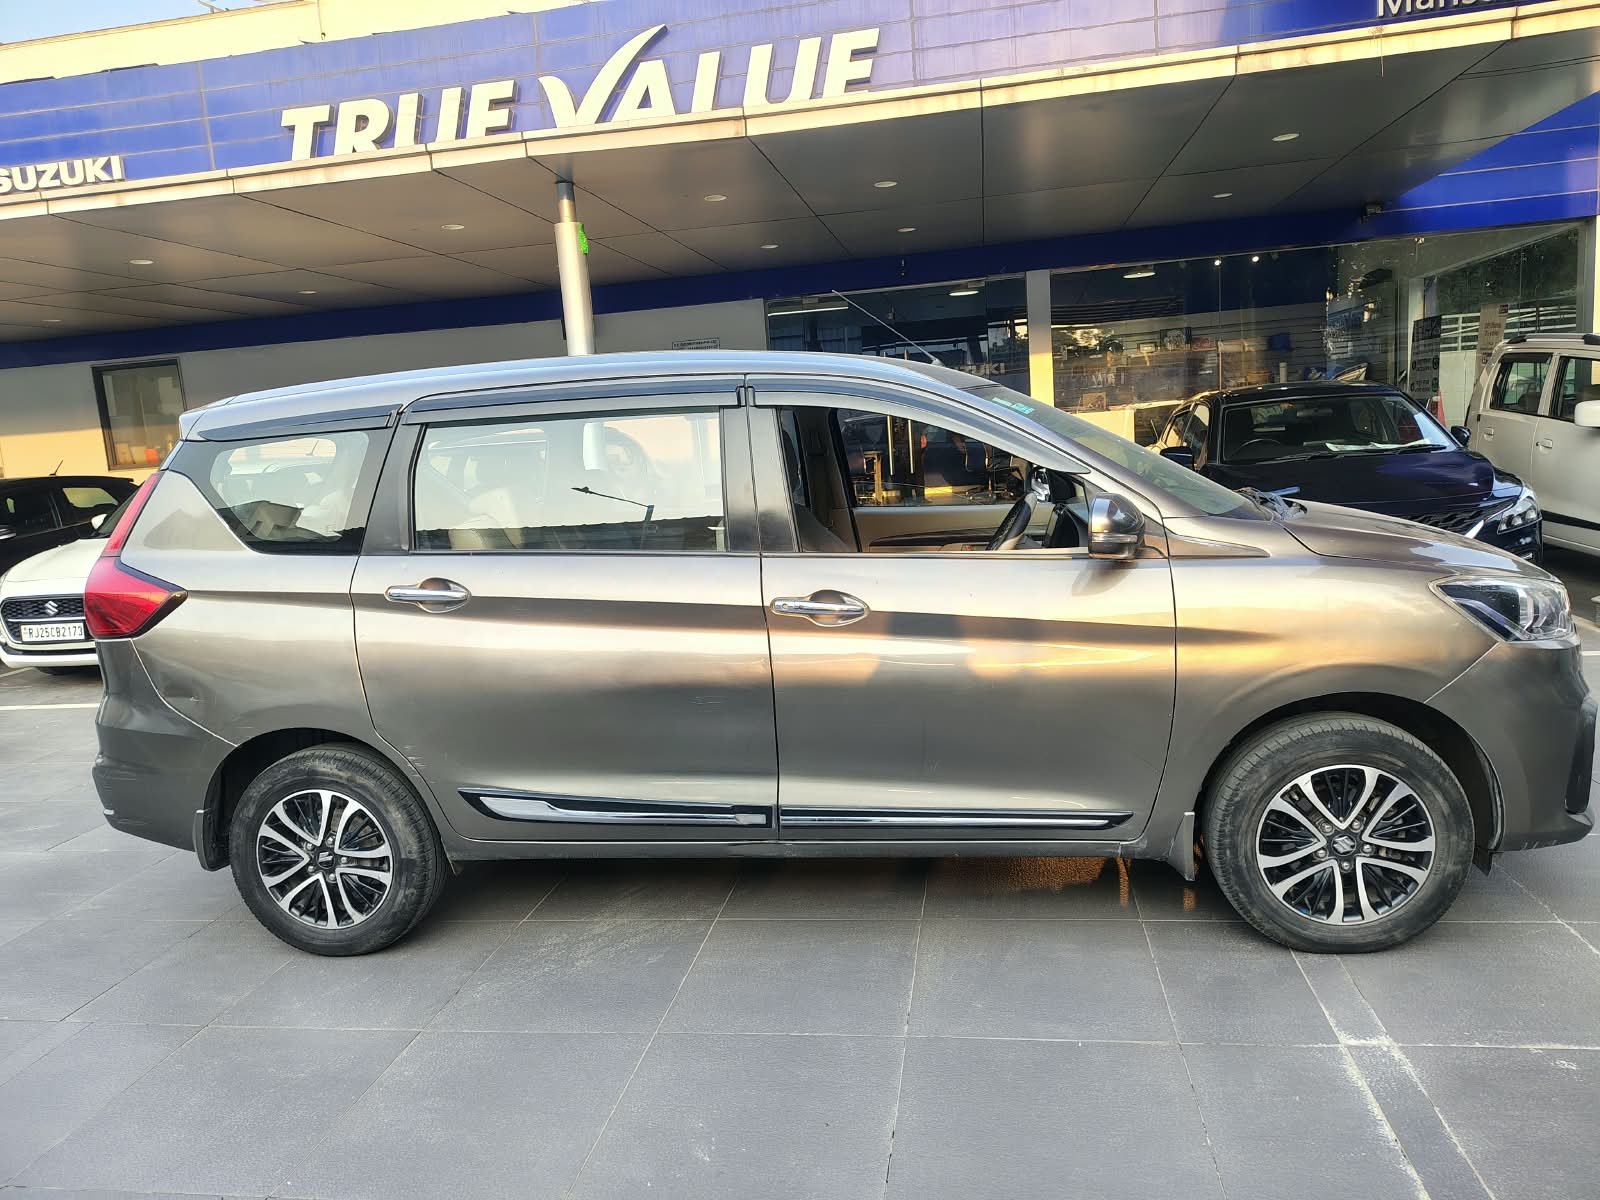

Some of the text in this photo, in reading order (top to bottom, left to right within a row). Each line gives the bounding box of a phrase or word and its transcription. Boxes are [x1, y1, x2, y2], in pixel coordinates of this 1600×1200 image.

[281, 23, 880, 161] TRUE VALUE
[28, 625, 83, 639] RJ25CB2173
